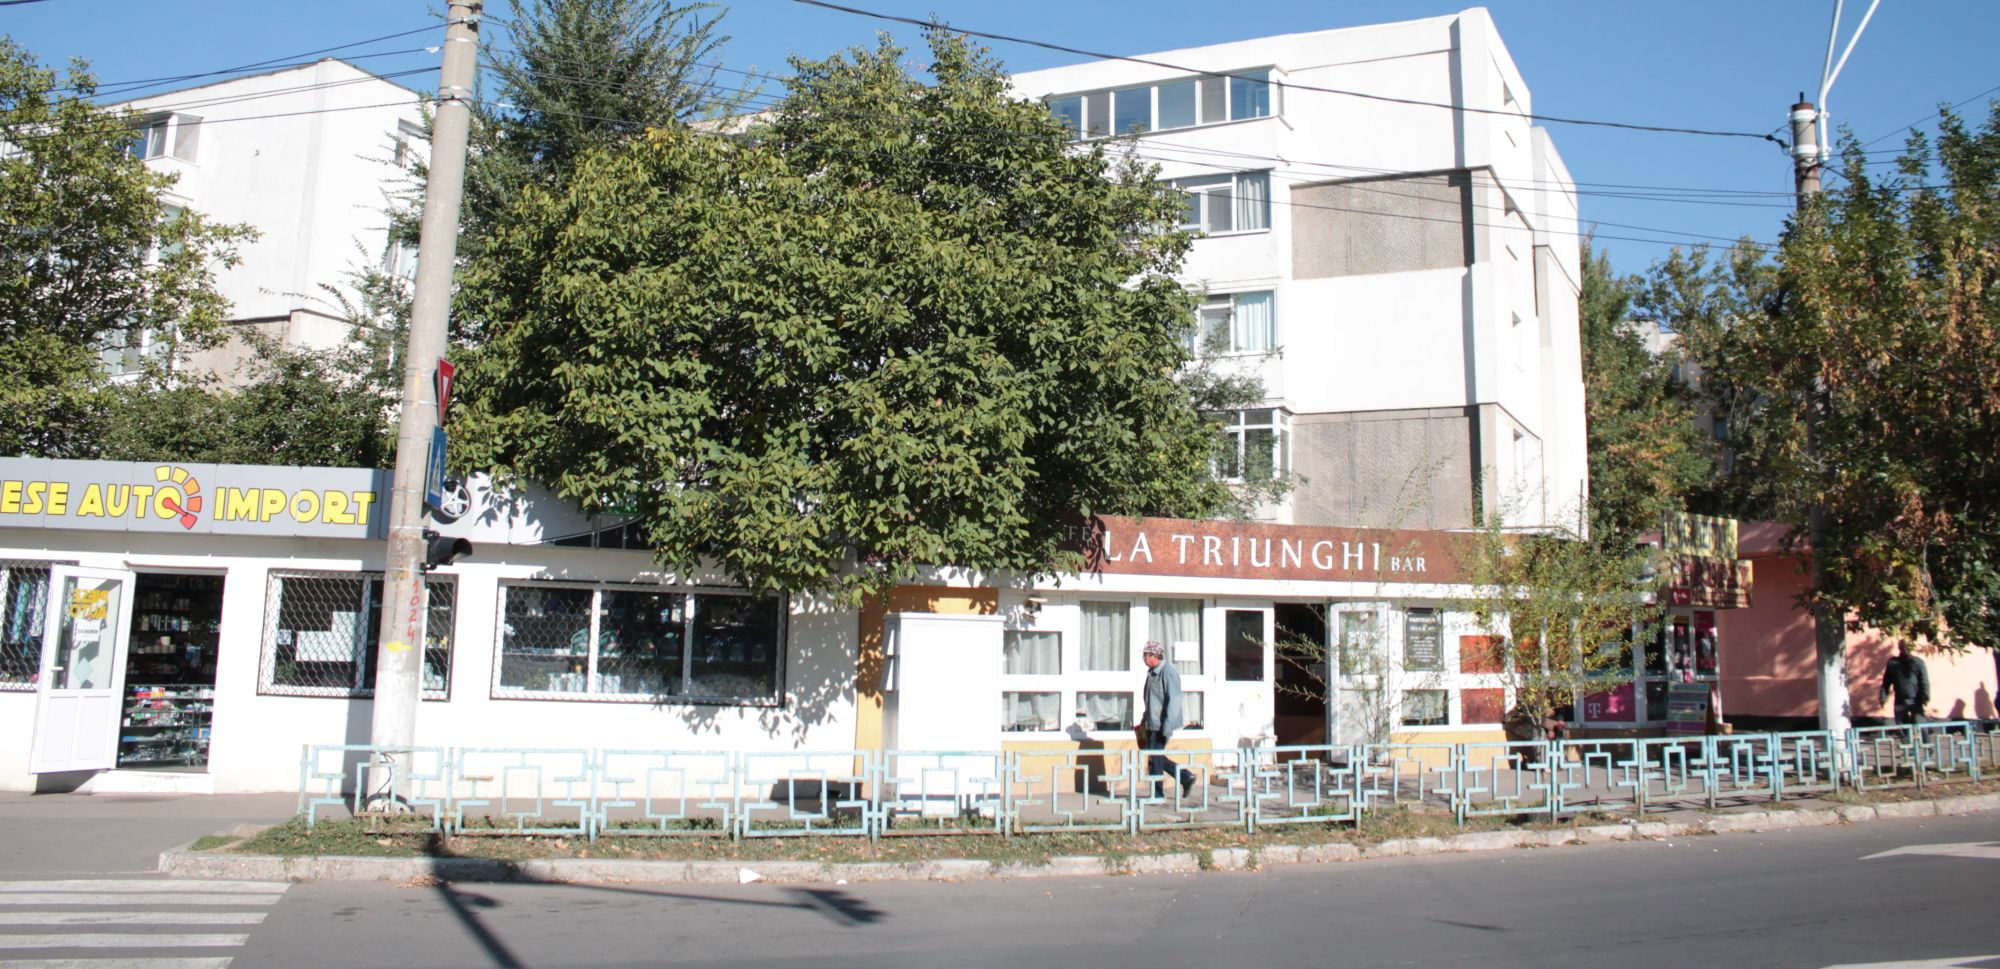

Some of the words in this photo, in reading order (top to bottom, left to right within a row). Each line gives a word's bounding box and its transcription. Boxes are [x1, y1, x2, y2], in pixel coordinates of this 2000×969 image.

[0, 480, 69, 516] ESE
[76, 482, 182, 520] AUTO
[213, 486, 377, 525] IMPORT
[1104, 530, 1153, 563] LA
[1171, 534, 1380, 571] TRIUNGHI
[1391, 557, 1426, 572] BAR
